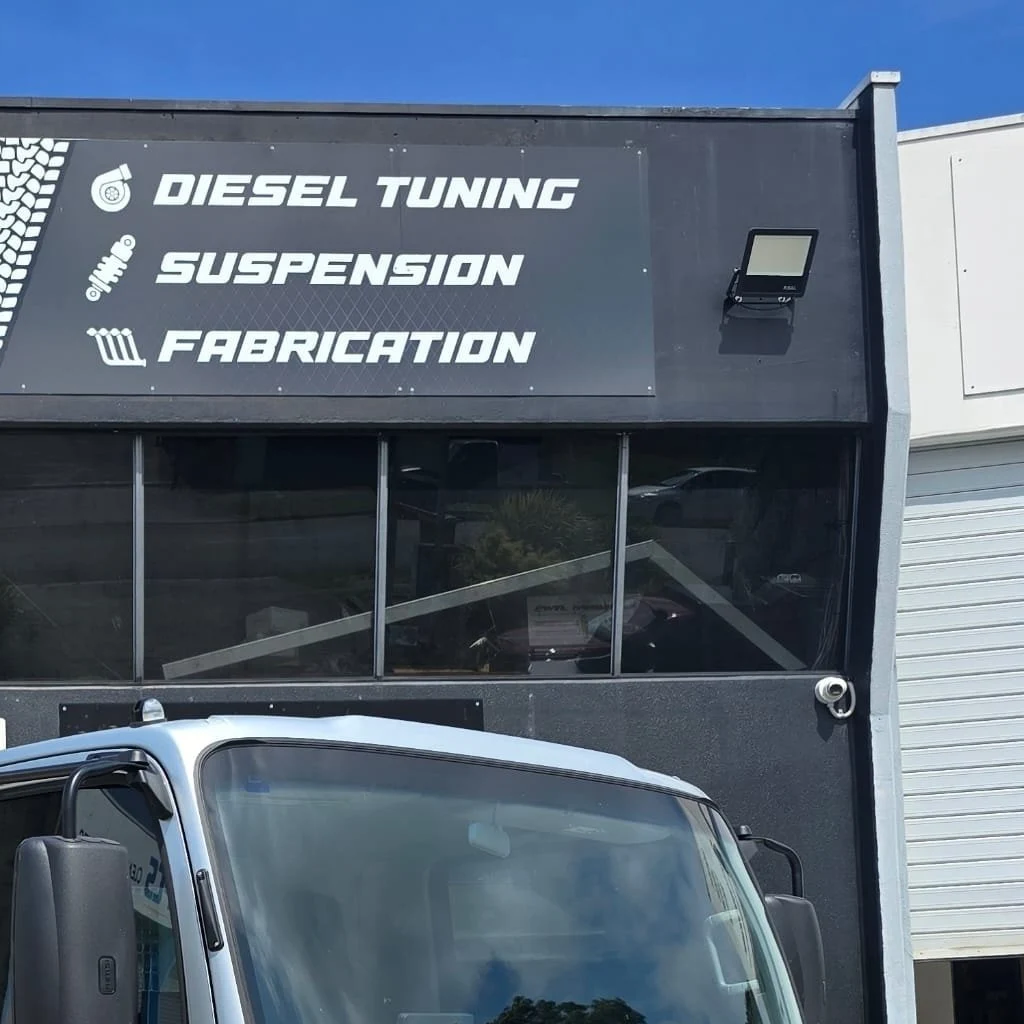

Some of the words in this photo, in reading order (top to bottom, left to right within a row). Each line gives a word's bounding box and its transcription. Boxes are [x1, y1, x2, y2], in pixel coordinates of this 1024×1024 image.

[153, 173, 359, 208] DIESEL
[376, 176, 580, 210] TUNING
[155, 251, 525, 287] SUSPENSION
[157, 330, 537, 364] FABRICATION
